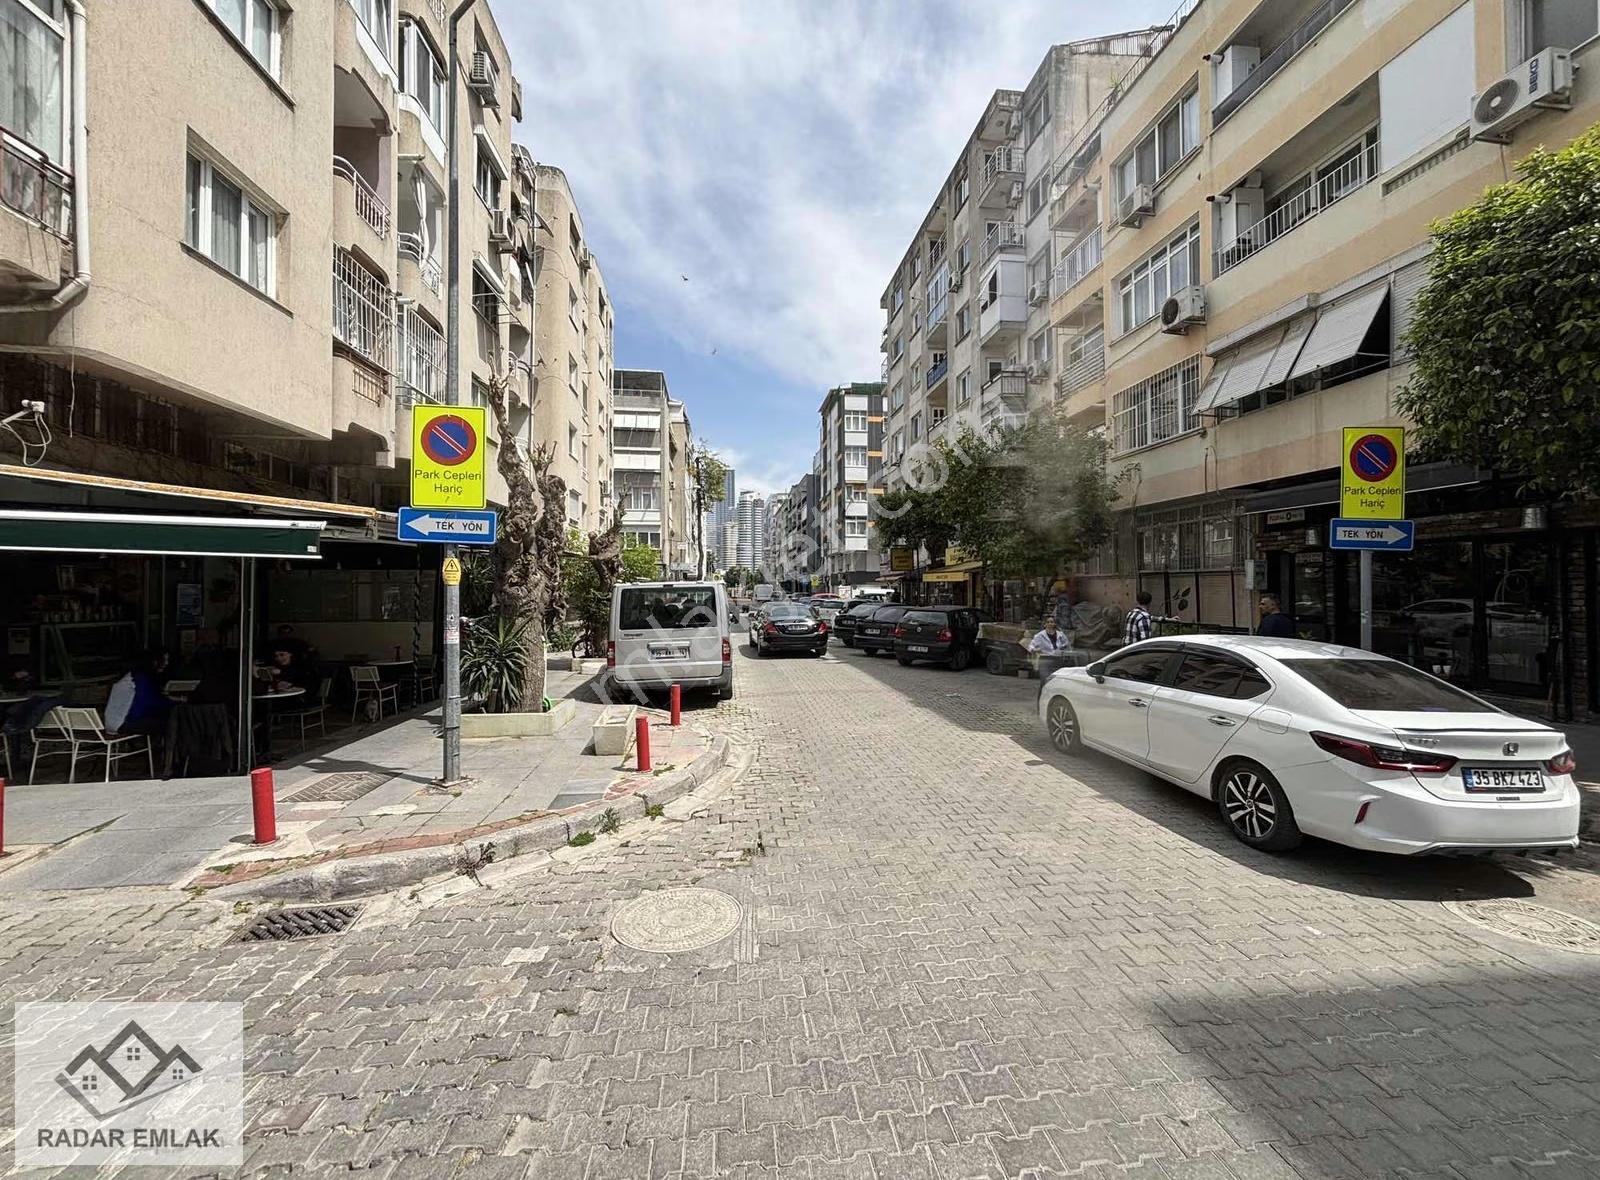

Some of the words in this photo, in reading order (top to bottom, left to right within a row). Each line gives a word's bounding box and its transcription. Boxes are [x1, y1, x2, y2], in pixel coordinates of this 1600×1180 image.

[1528, 58, 1538, 94] BEKO
[414, 469, 440, 479] Park
[443, 470, 482, 482] Cepleri
[434, 483, 463, 495] Hariç
[1344, 487, 1366, 495] Park
[1368, 486, 1401, 496] Cepleri
[1360, 498, 1385, 509] Hariç
[435, 521, 455, 530] TEK
[462, 520, 483, 531] YÖN
[1342, 529, 1359, 538] TEK
[1365, 529, 1383, 539] YÖN
[1473, 771, 1490, 786] 35
[1494, 771, 1516, 786] BKZ
[1518, 771, 1540, 786] 423
